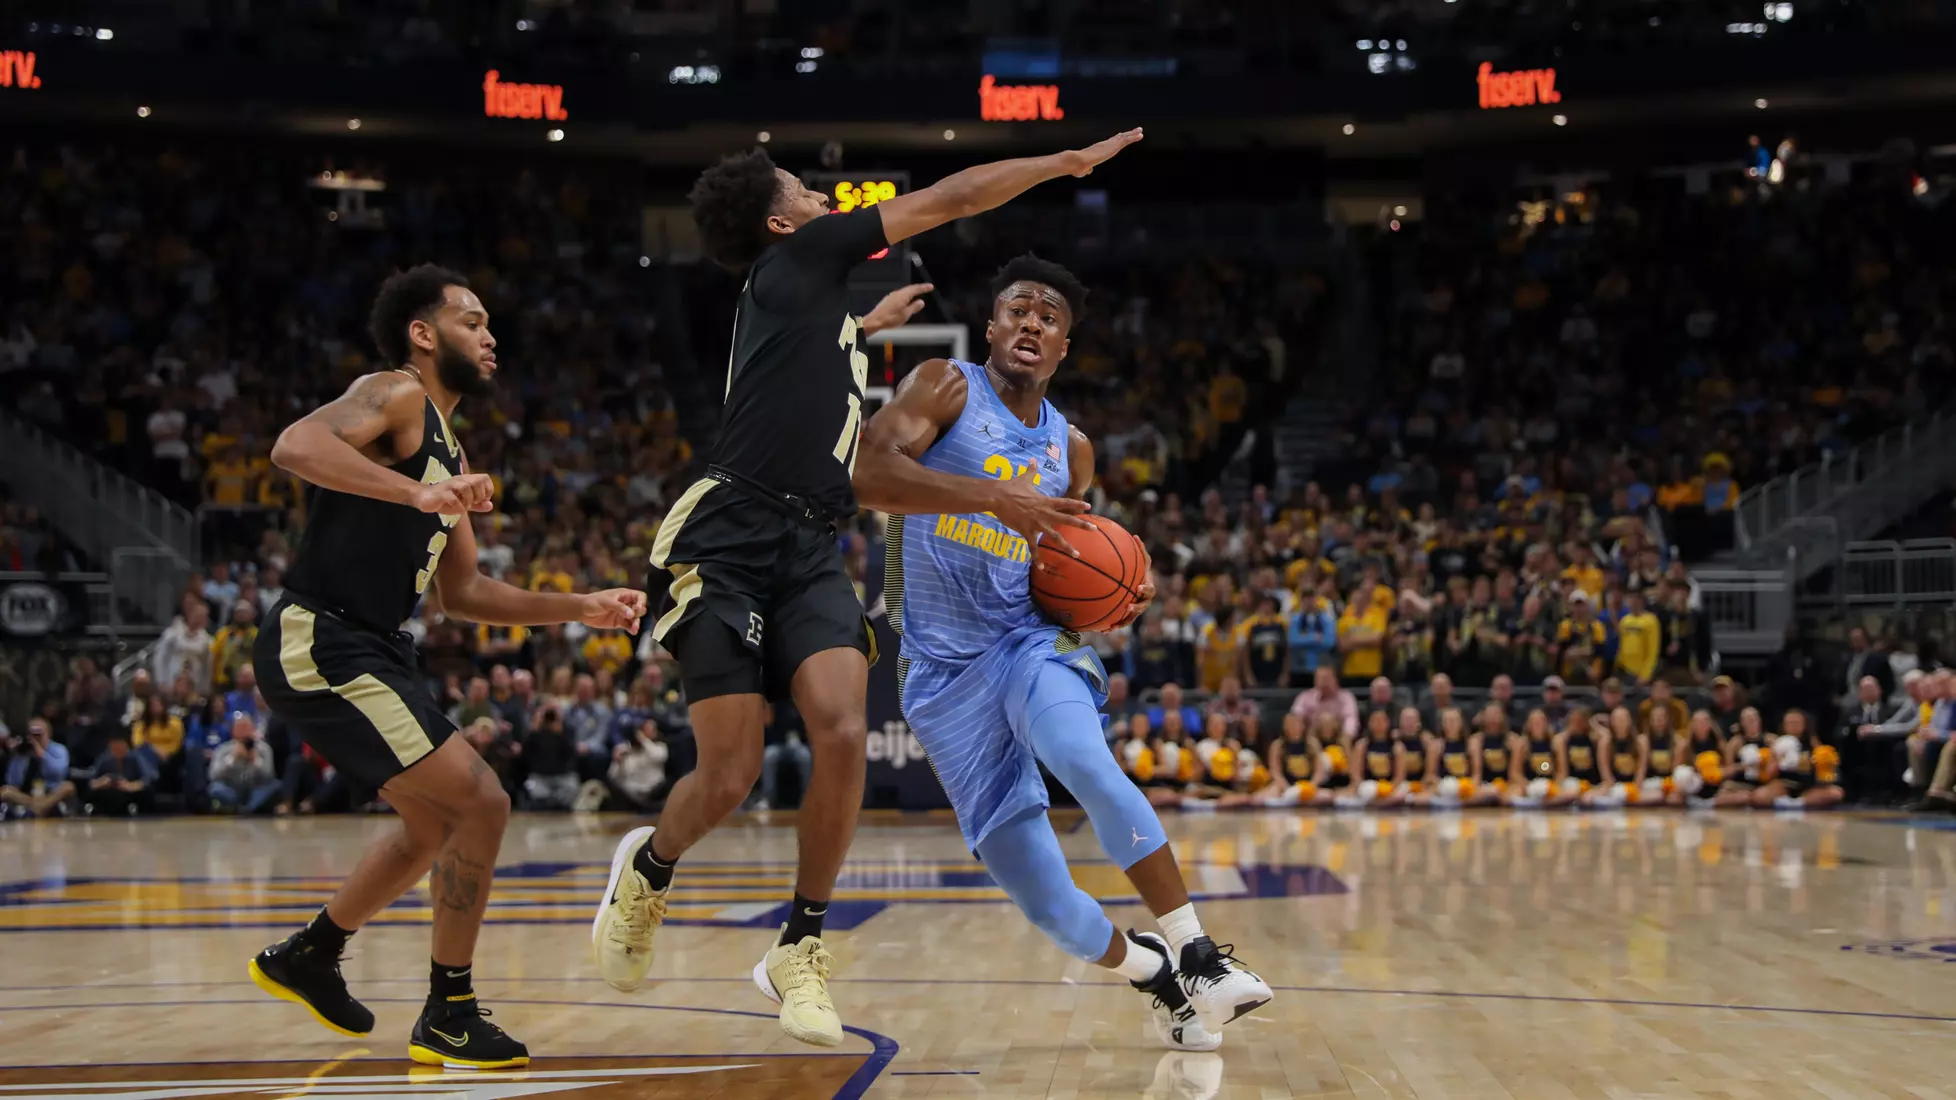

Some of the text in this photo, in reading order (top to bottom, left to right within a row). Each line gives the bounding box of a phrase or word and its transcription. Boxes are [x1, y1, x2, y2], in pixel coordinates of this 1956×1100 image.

[415, 530, 447, 594] 3
[935, 513, 1032, 563] MARQUETT
[866, 720, 927, 770] eije
